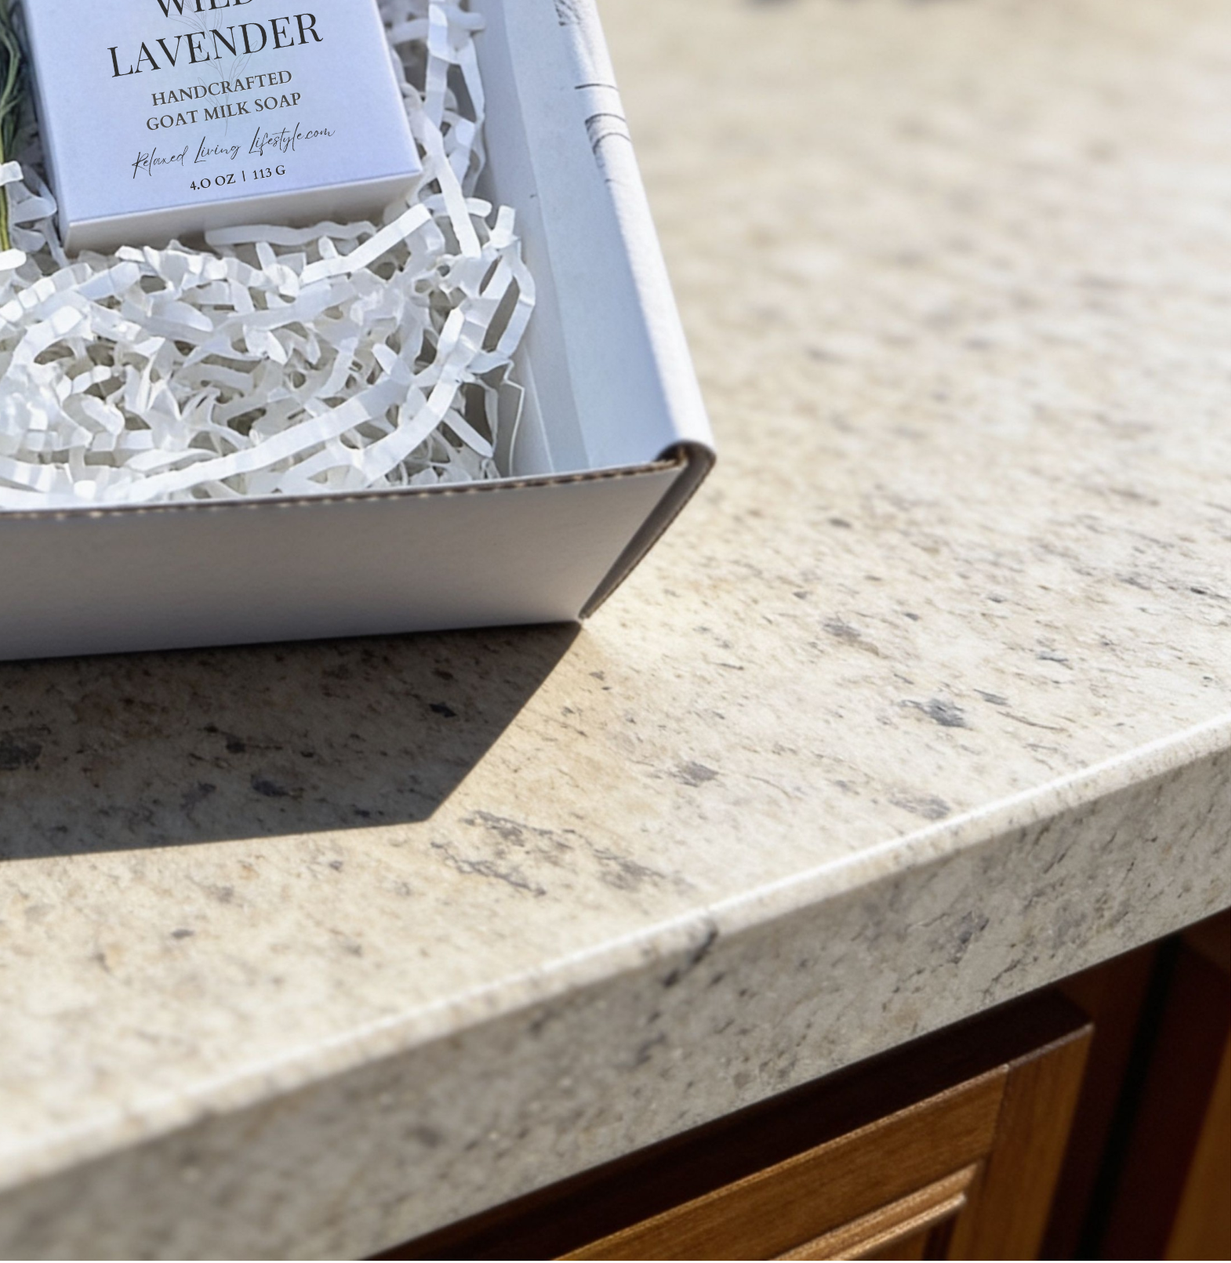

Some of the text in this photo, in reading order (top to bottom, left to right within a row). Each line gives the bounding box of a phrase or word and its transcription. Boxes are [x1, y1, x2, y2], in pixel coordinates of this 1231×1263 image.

[107, 13, 324, 78] LAVENDER
[151, 70, 292, 106] HANDCRAFTED
[146, 92, 302, 131] GOAT MILK SOAP
[132, 122, 335, 179] Relaxed Living Lifestyle.com
[215, 173, 236, 188] OZ
[253, 168, 272, 181] 113
[275, 164, 287, 176] G
